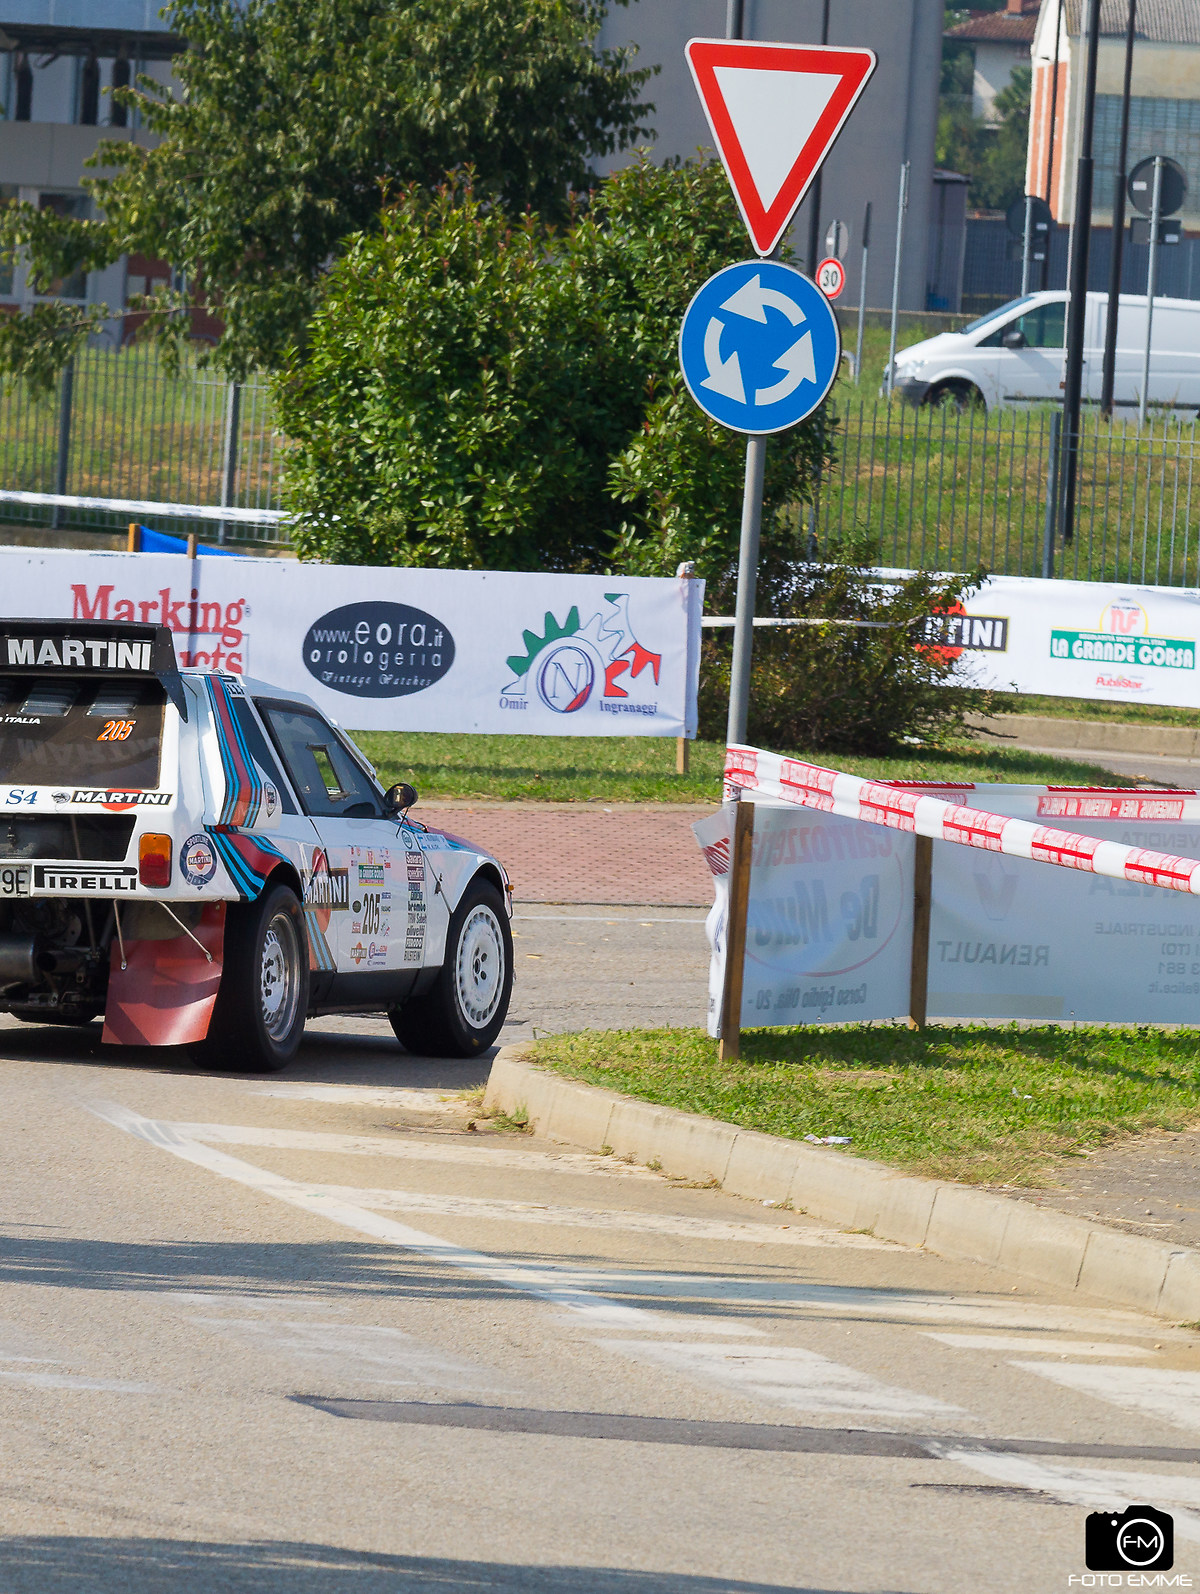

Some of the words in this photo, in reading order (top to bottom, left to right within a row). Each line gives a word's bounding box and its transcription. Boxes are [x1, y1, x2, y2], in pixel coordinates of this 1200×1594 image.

[823, 270, 838, 287] 30
[71, 584, 246, 648] Marking
[311, 620, 444, 648] www.eora.it
[7, 639, 152, 672] MARTINI
[310, 643, 442, 670] orologeria
[1052, 638, 1069, 658] LA
[1072, 640, 1135, 663] GRANDE
[1139, 644, 1194, 668] CORSA
[499, 697, 529, 712] Omir
[600, 701, 658, 716] Ingranaggi
[5, 714, 41, 725] ITALIA
[97, 720, 137, 742] 205
[5, 789, 39, 805] S4
[72, 791, 172, 805] MARTINI
[34, 865, 138, 891] PIRELLI
[362, 892, 380, 935] 205
